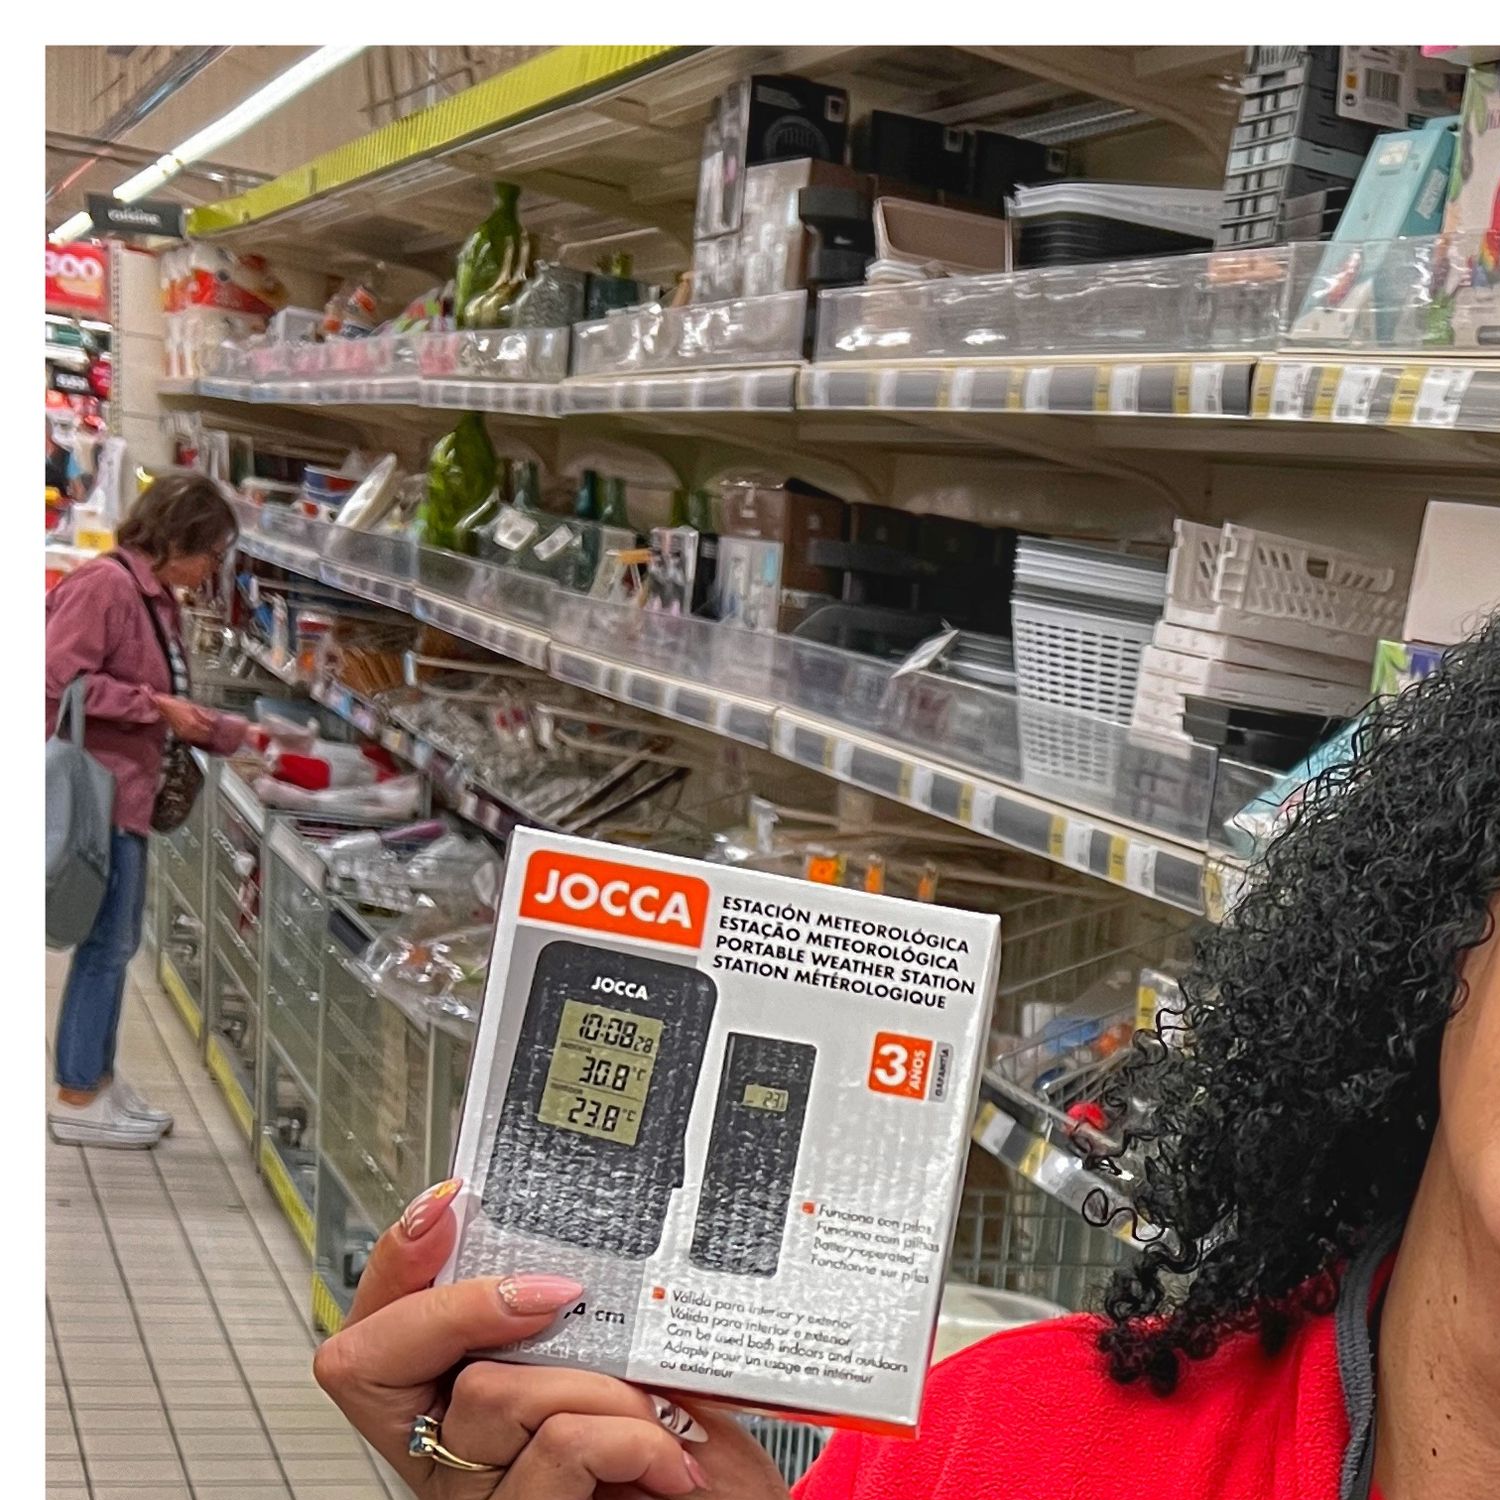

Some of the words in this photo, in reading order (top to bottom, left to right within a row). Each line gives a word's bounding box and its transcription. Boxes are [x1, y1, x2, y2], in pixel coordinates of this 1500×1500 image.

[534, 869, 692, 929] JOCCA
[723, 896, 811, 924] ESTACIÓN
[816, 913, 969, 954] METEOROLÓGICA
[716, 935, 804, 963] PORTABLE
[812, 951, 894, 980] WEATHER
[901, 969, 976, 994] STATION
[719, 916, 800, 941] ESTAÇÃO
[806, 931, 959, 972] METEOROLÓGICA
[591, 976, 648, 1000] JOCCA
[713, 955, 788, 980] STATION
[794, 968, 946, 1009] MÉTÉROLOGIQUE
[874, 1043, 908, 1087] 3
[909, 1049, 926, 1091] AÑOS
[594, 1309, 625, 1324] cm
